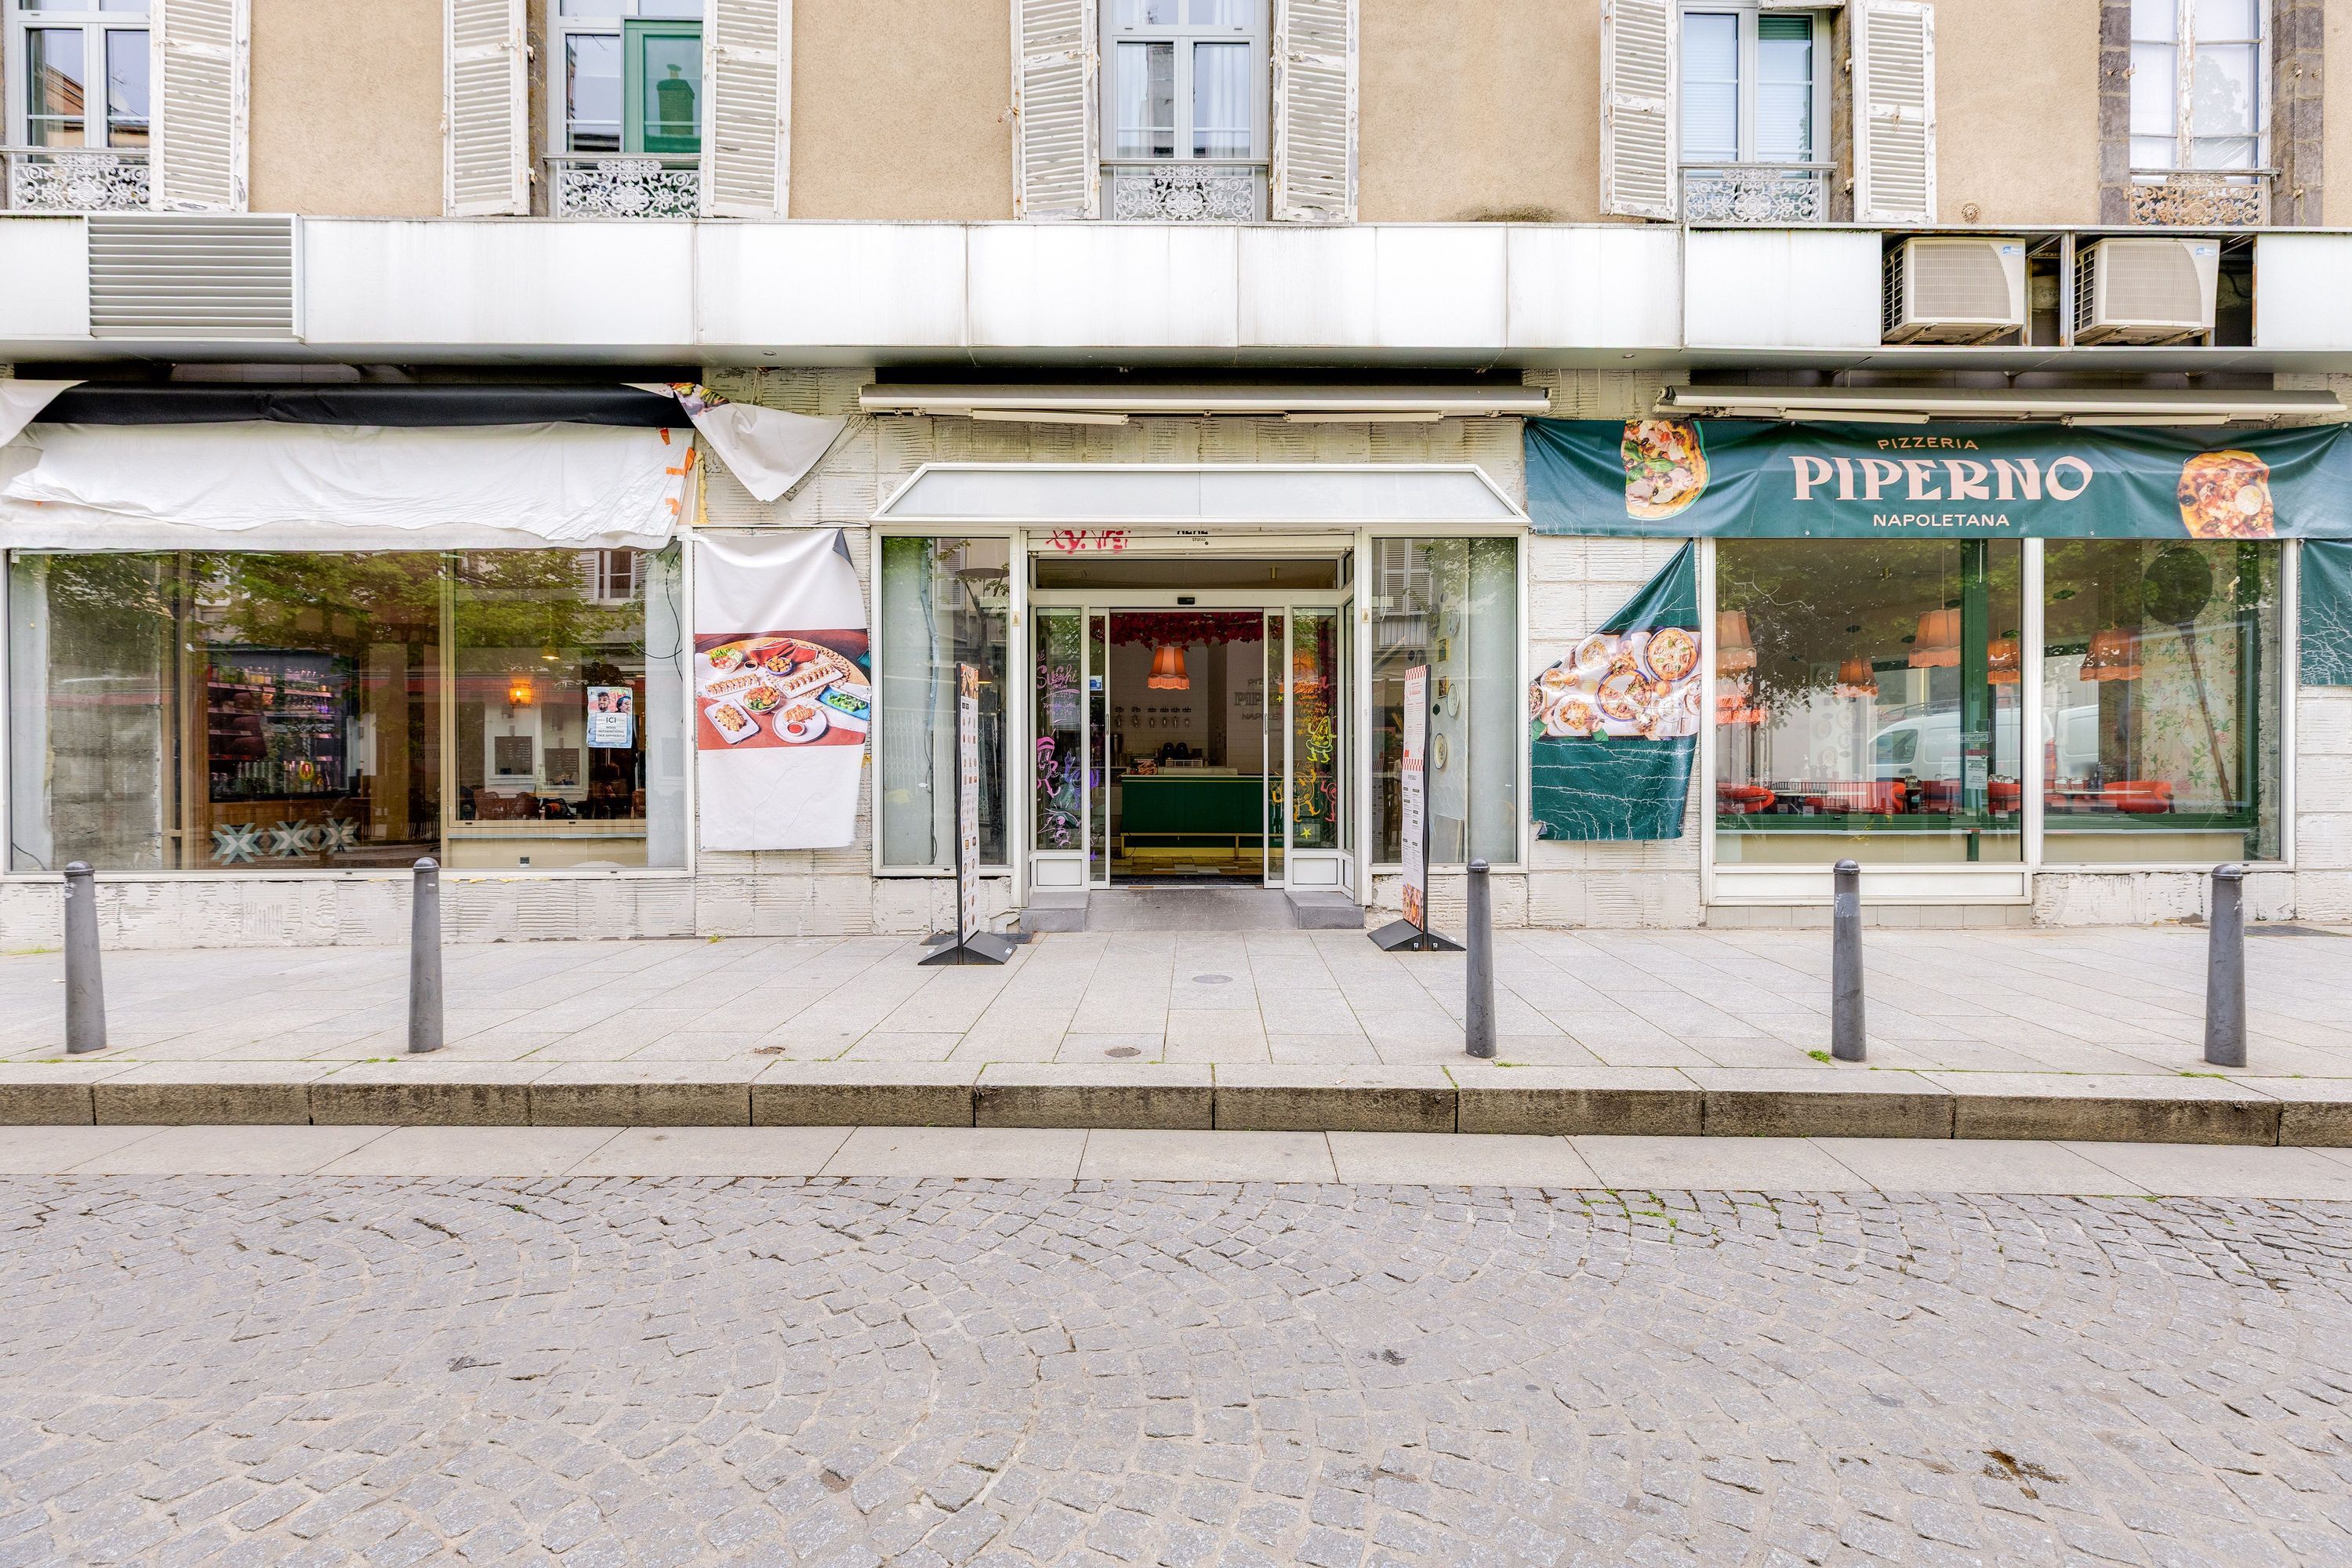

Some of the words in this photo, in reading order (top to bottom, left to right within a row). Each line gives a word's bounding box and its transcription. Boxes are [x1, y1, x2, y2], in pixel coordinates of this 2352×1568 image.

[1877, 437, 1980, 450] PIZZERIA
[1788, 456, 2094, 501] PIPERNO
[1872, 514, 2010, 527] NAPOLETANA
